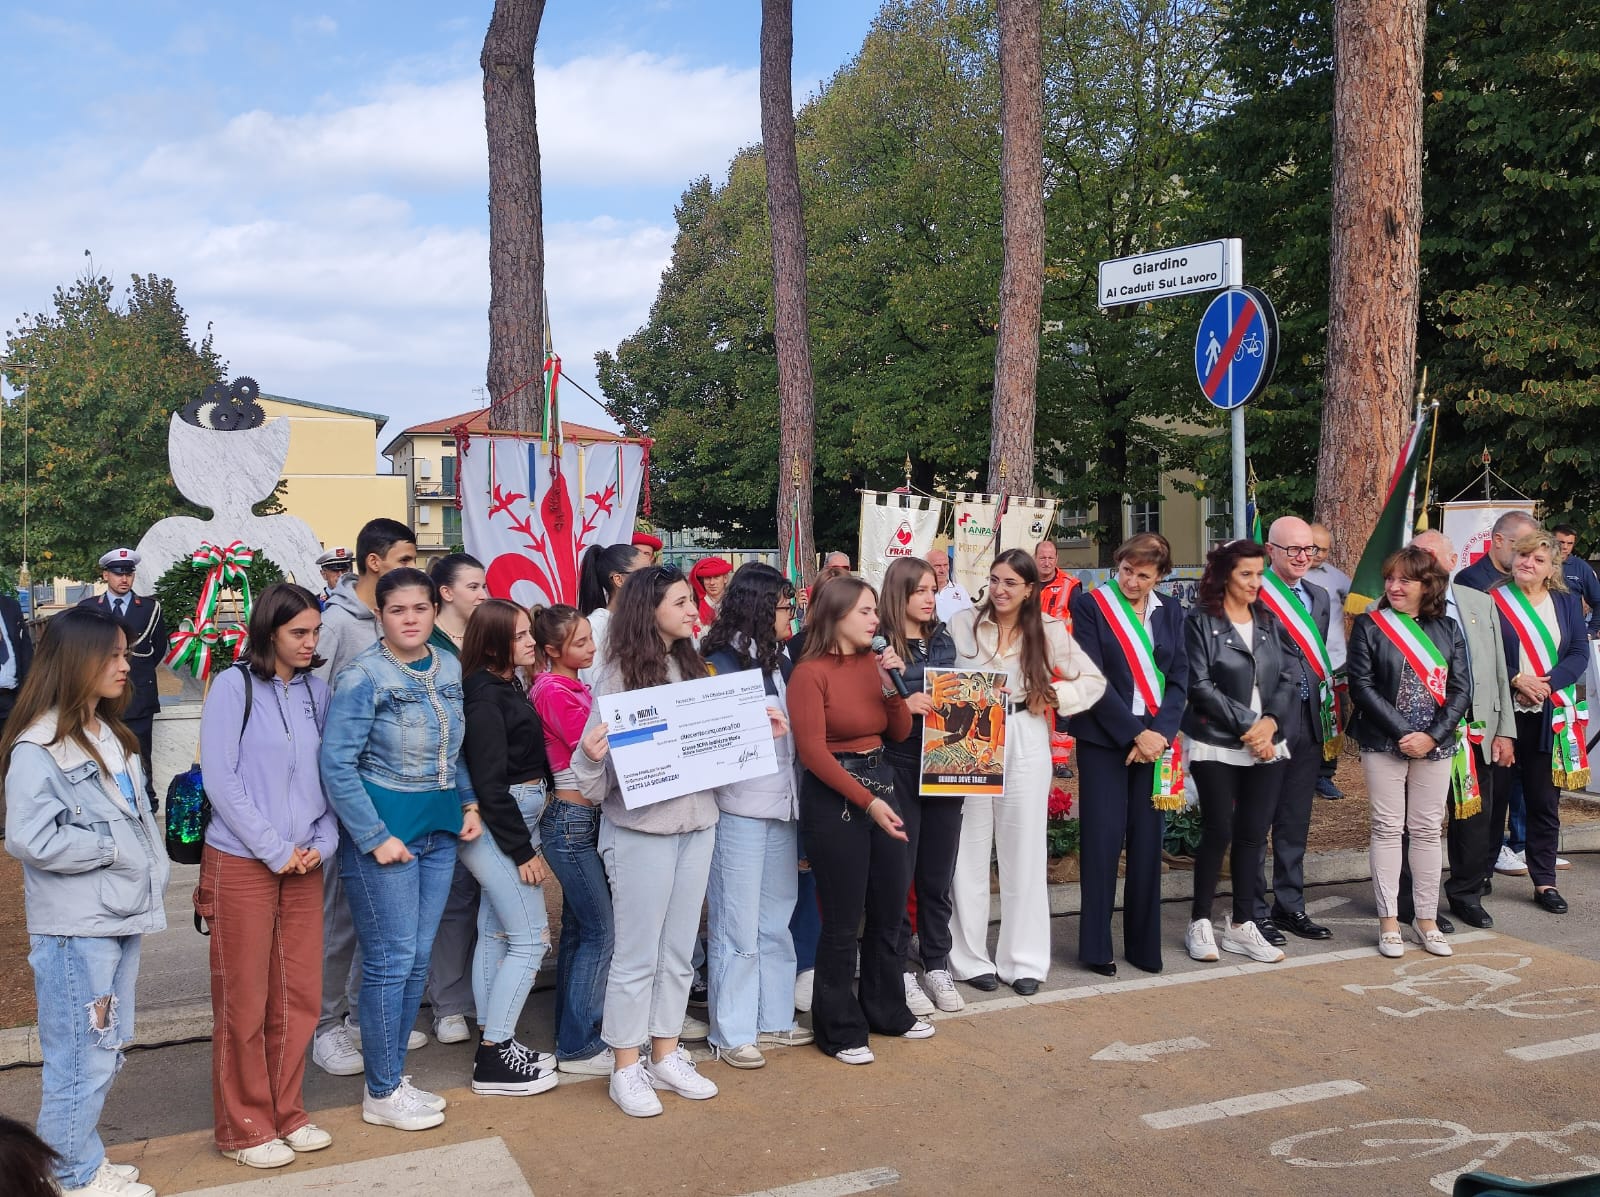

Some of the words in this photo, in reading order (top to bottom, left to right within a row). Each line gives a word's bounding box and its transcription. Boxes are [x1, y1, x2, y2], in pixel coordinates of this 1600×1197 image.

[1133, 258, 1187, 275] Giardino
[1120, 281, 1154, 296] Caduti
[1158, 277, 1177, 289] Sul
[1180, 272, 1217, 286] Lavoro
